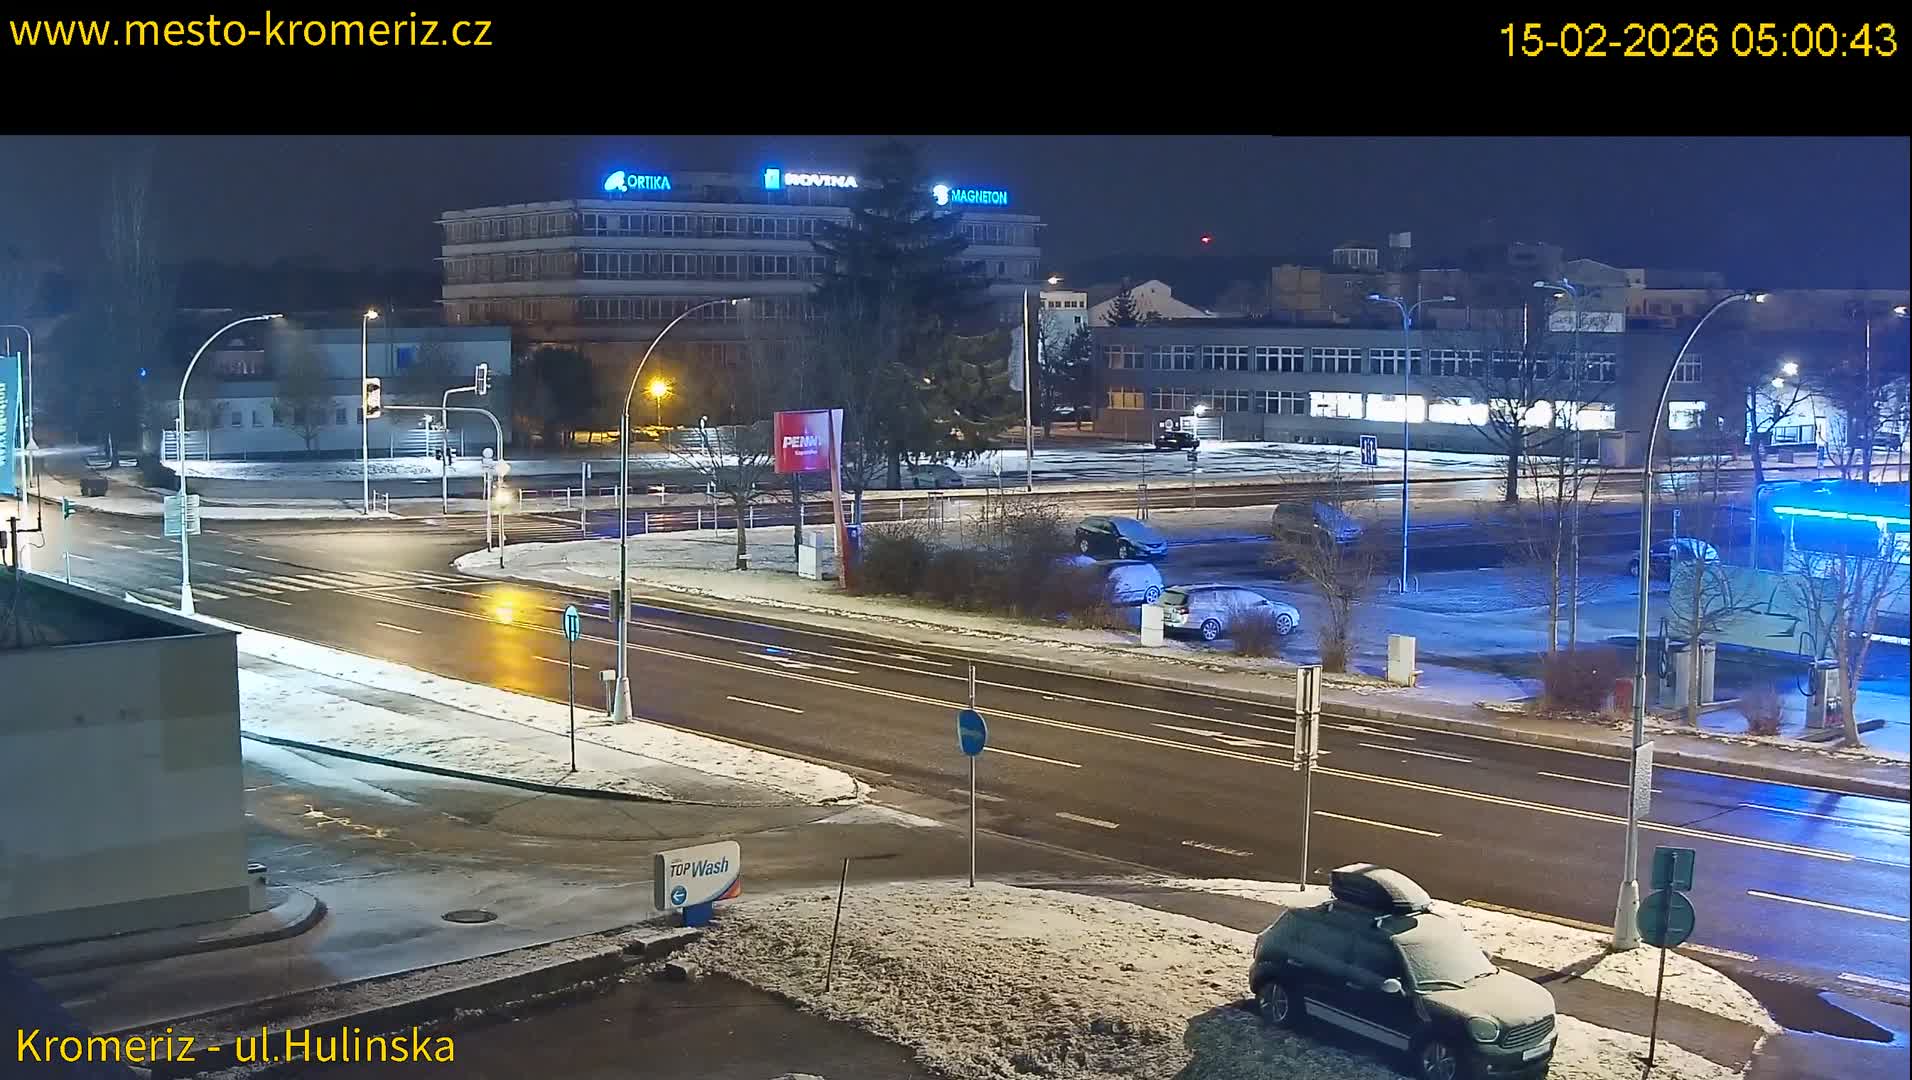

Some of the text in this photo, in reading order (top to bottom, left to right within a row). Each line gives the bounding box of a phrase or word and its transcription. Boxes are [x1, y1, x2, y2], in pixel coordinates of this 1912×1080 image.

[627, 174, 672, 190] ORTIKA
[951, 188, 1008, 205] MAGNETON
[783, 435, 821, 448] PENN
[671, 855, 729, 878] TOP Wash
